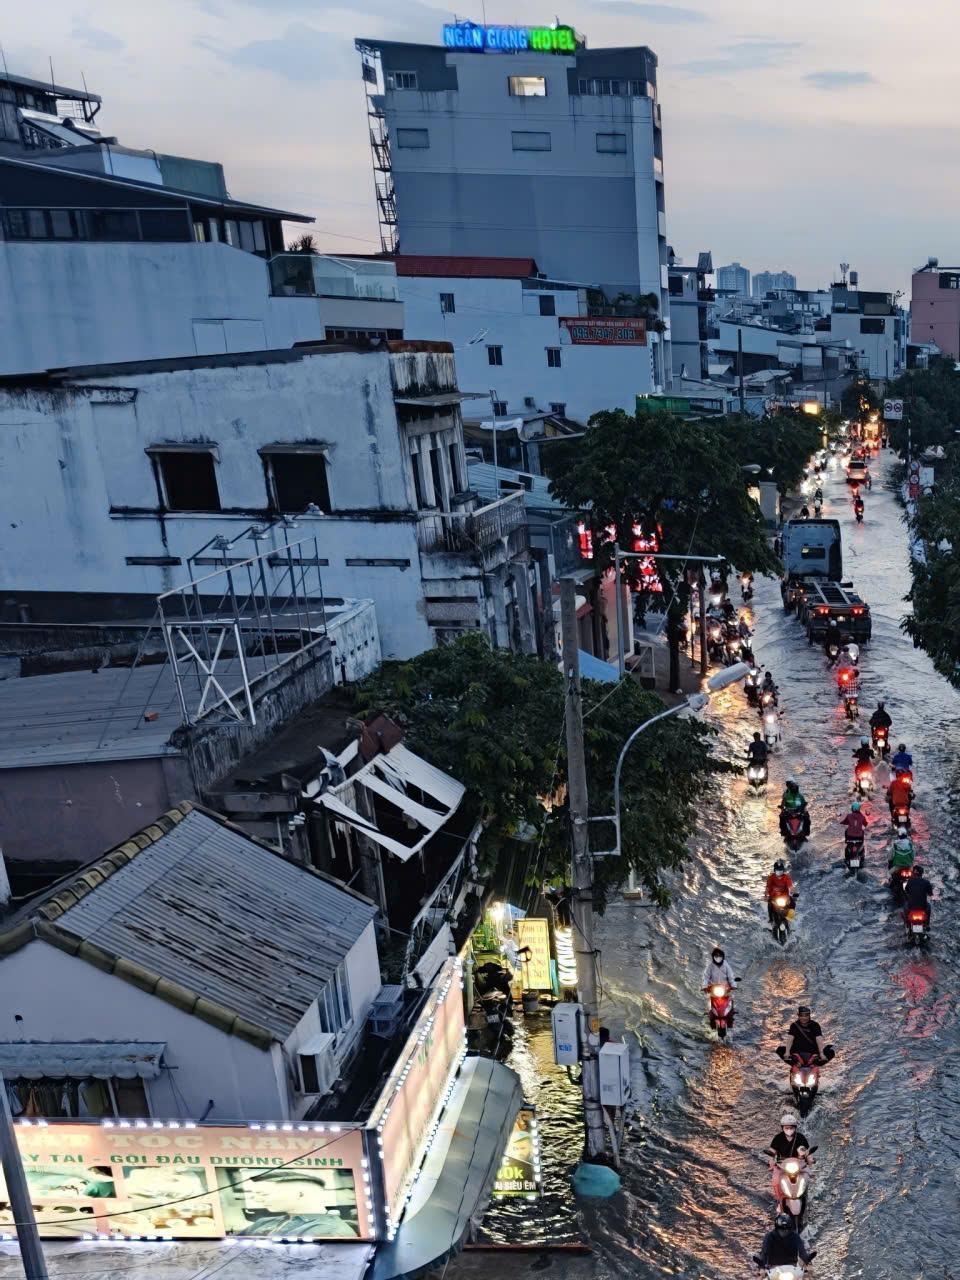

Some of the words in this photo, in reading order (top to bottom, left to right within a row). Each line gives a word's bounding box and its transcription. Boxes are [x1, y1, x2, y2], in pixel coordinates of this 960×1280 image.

[445, 22, 483, 47] NGÂN
[487, 28, 527, 49] GIANG
[532, 28, 575, 51] HOTEL
[219, 1136, 328, 1151] NAM
[48, 1153, 84, 1163] TAI
[293, 1156, 344, 1167] SINH
